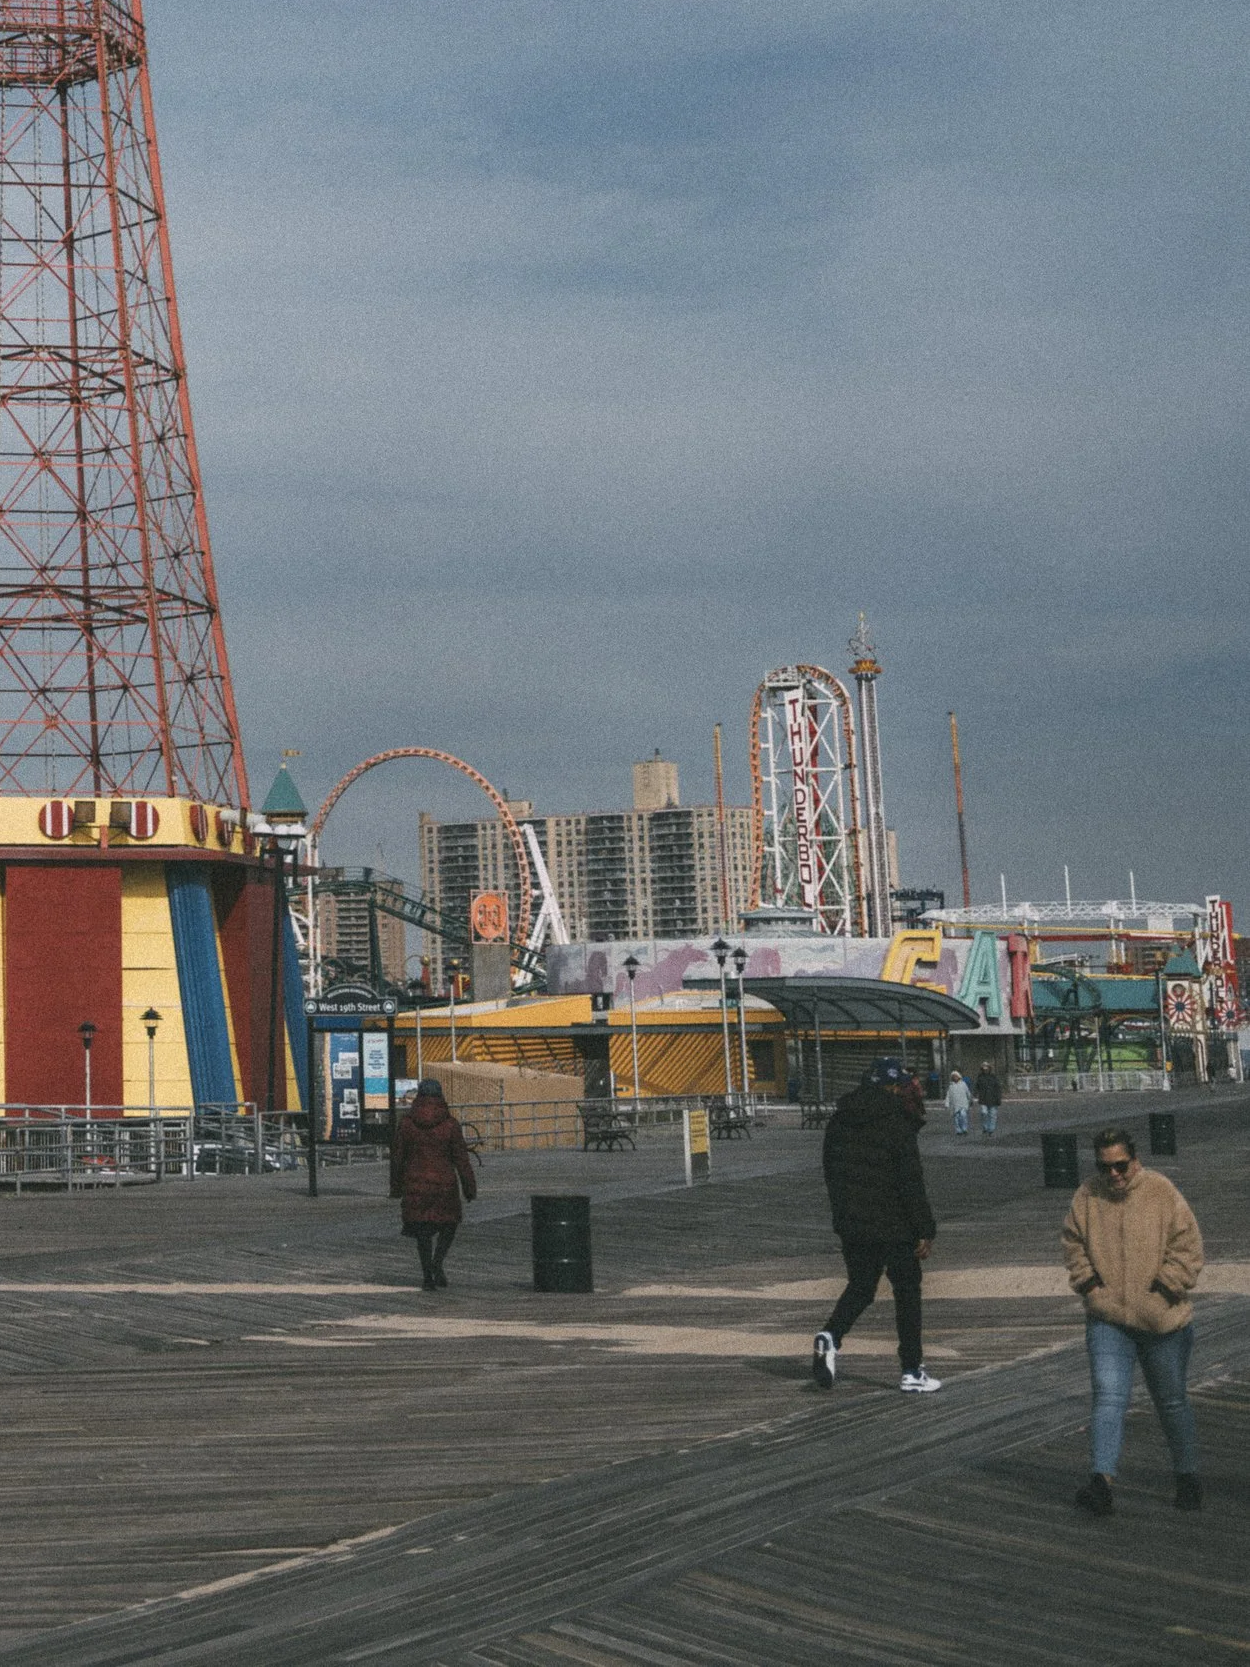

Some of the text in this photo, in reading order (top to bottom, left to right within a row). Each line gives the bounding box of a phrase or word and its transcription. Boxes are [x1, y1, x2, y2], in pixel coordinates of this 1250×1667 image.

[788, 698, 813, 909] THUNDERBOL
[319, 1003, 381, 1013] West 19th Street
